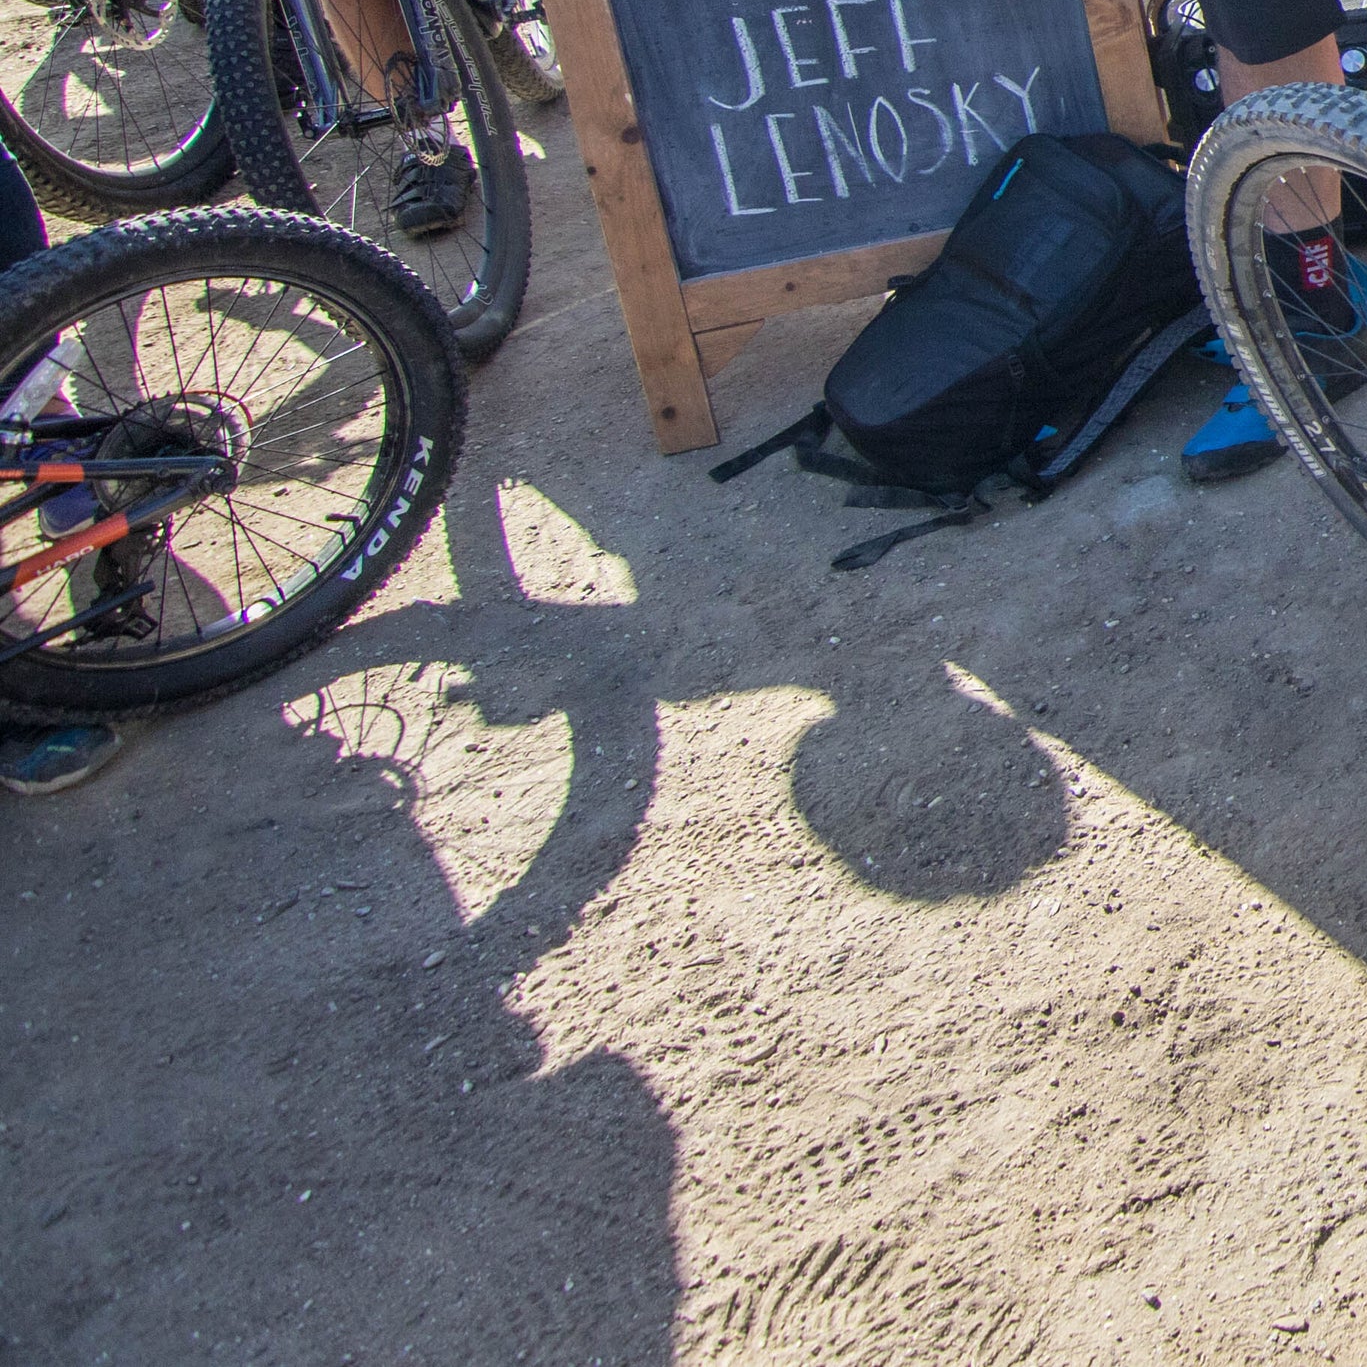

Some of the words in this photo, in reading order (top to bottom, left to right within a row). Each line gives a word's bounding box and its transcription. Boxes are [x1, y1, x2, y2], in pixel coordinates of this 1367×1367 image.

[710, 65, 1041, 216] LENOSKY
[341, 434, 435, 581] KENDA
[1303, 419, 1337, 456] 2.7
